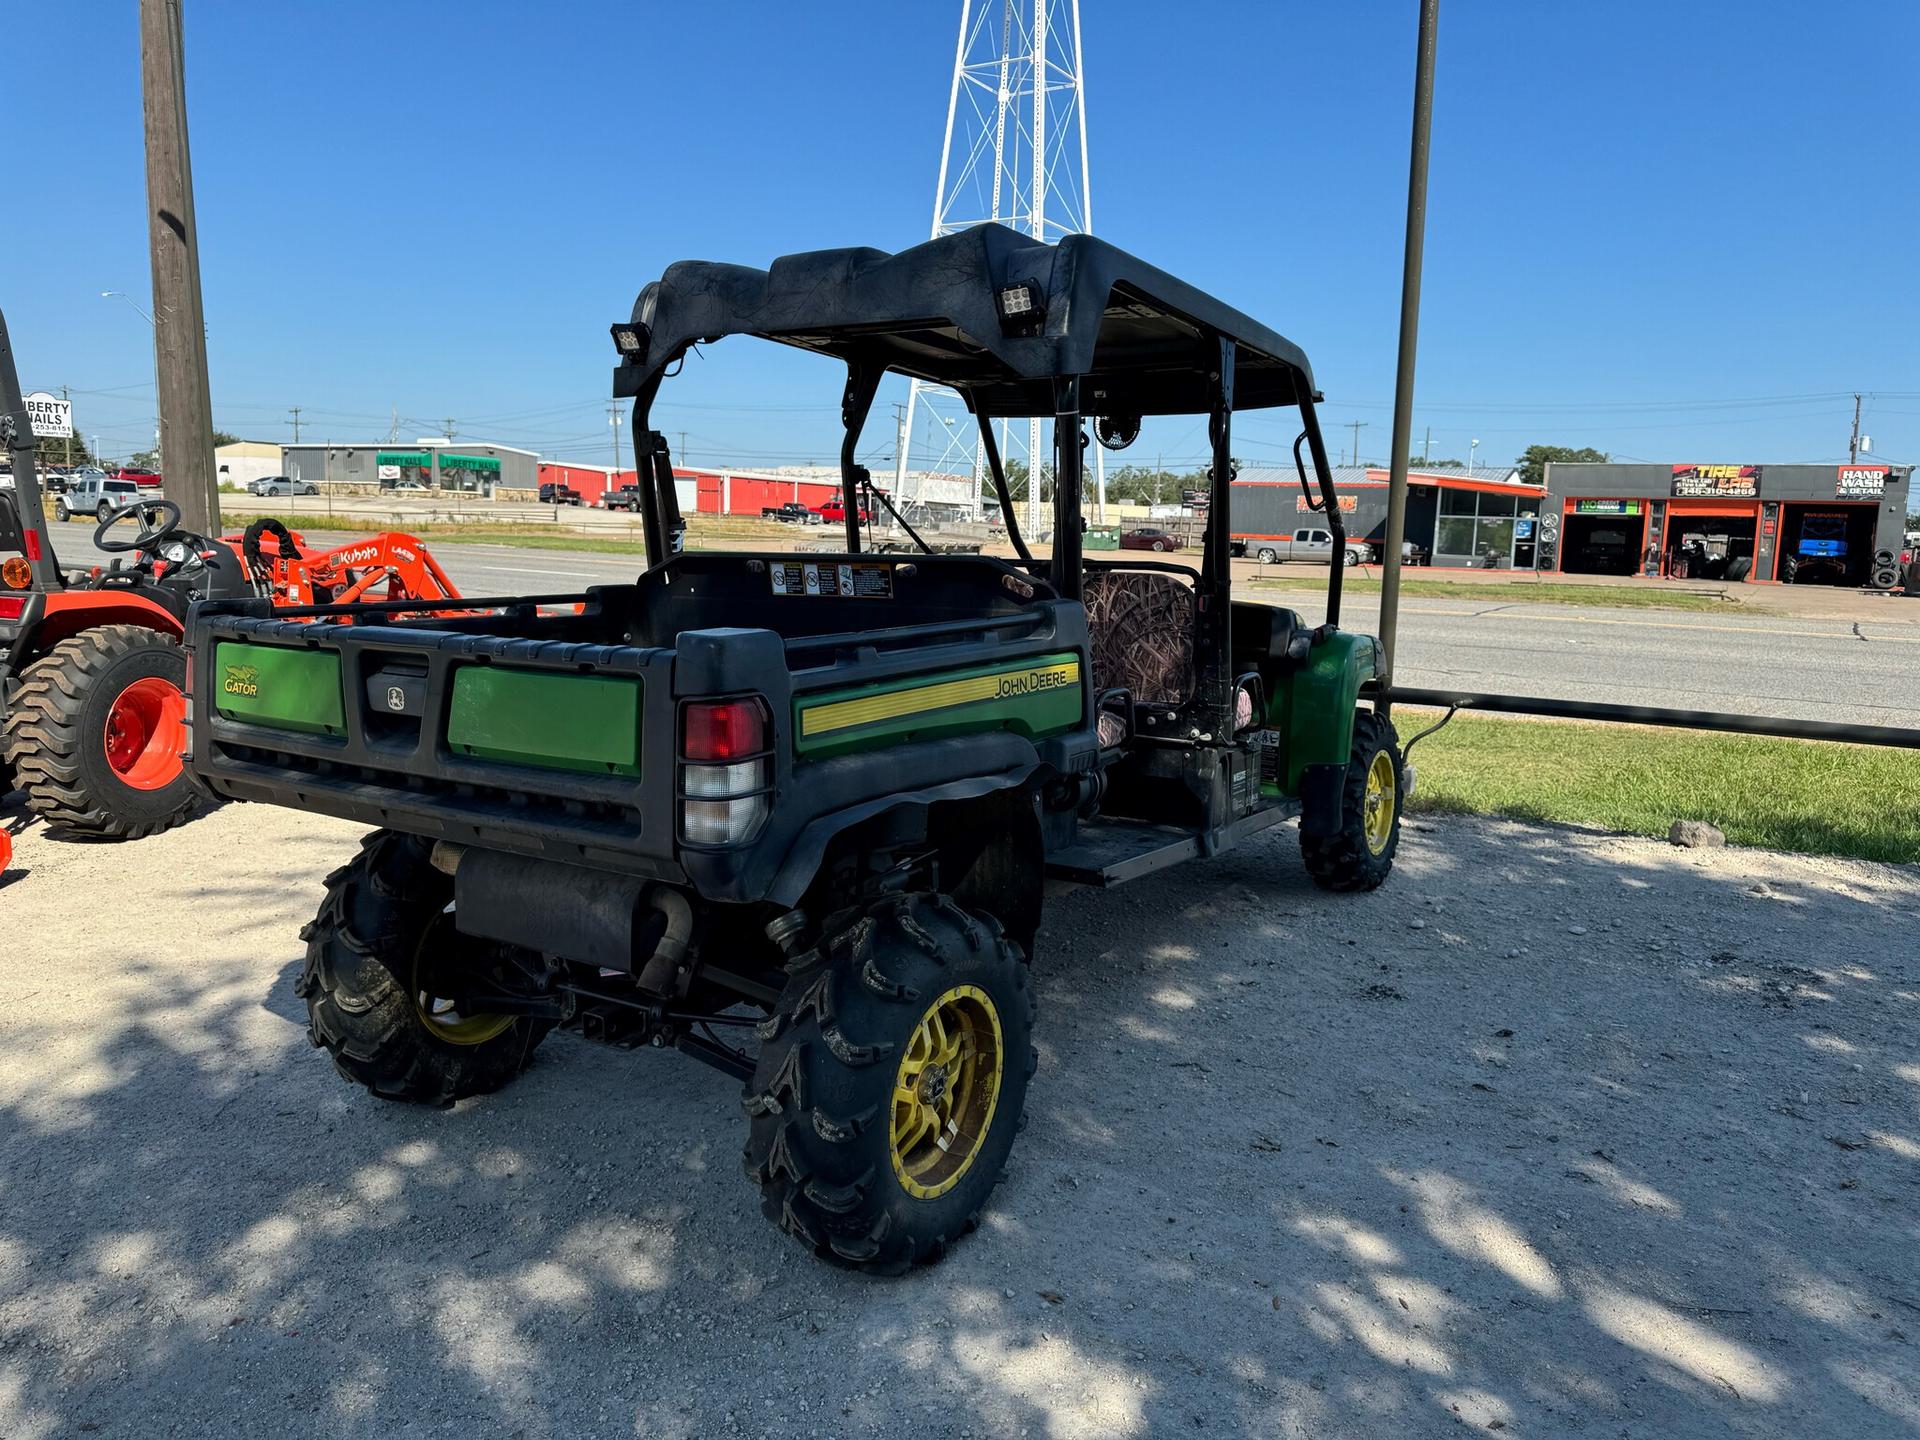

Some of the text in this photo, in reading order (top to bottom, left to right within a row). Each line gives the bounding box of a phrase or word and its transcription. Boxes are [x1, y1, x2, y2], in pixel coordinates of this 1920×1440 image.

[23, 401, 69, 414] IBERTY
[446, 459, 500, 470] LIBERTY NAILS
[1697, 465, 1740, 478] TIRE
[1843, 470, 1884, 479] HAND
[1718, 477, 1755, 489] LAB
[1841, 479, 1884, 488] WASH
[1581, 500, 1597, 510] NO
[340, 546, 378, 565] Kubota
[225, 679, 257, 696] GATOR
[994, 670, 1067, 698] JOHN DEERE
